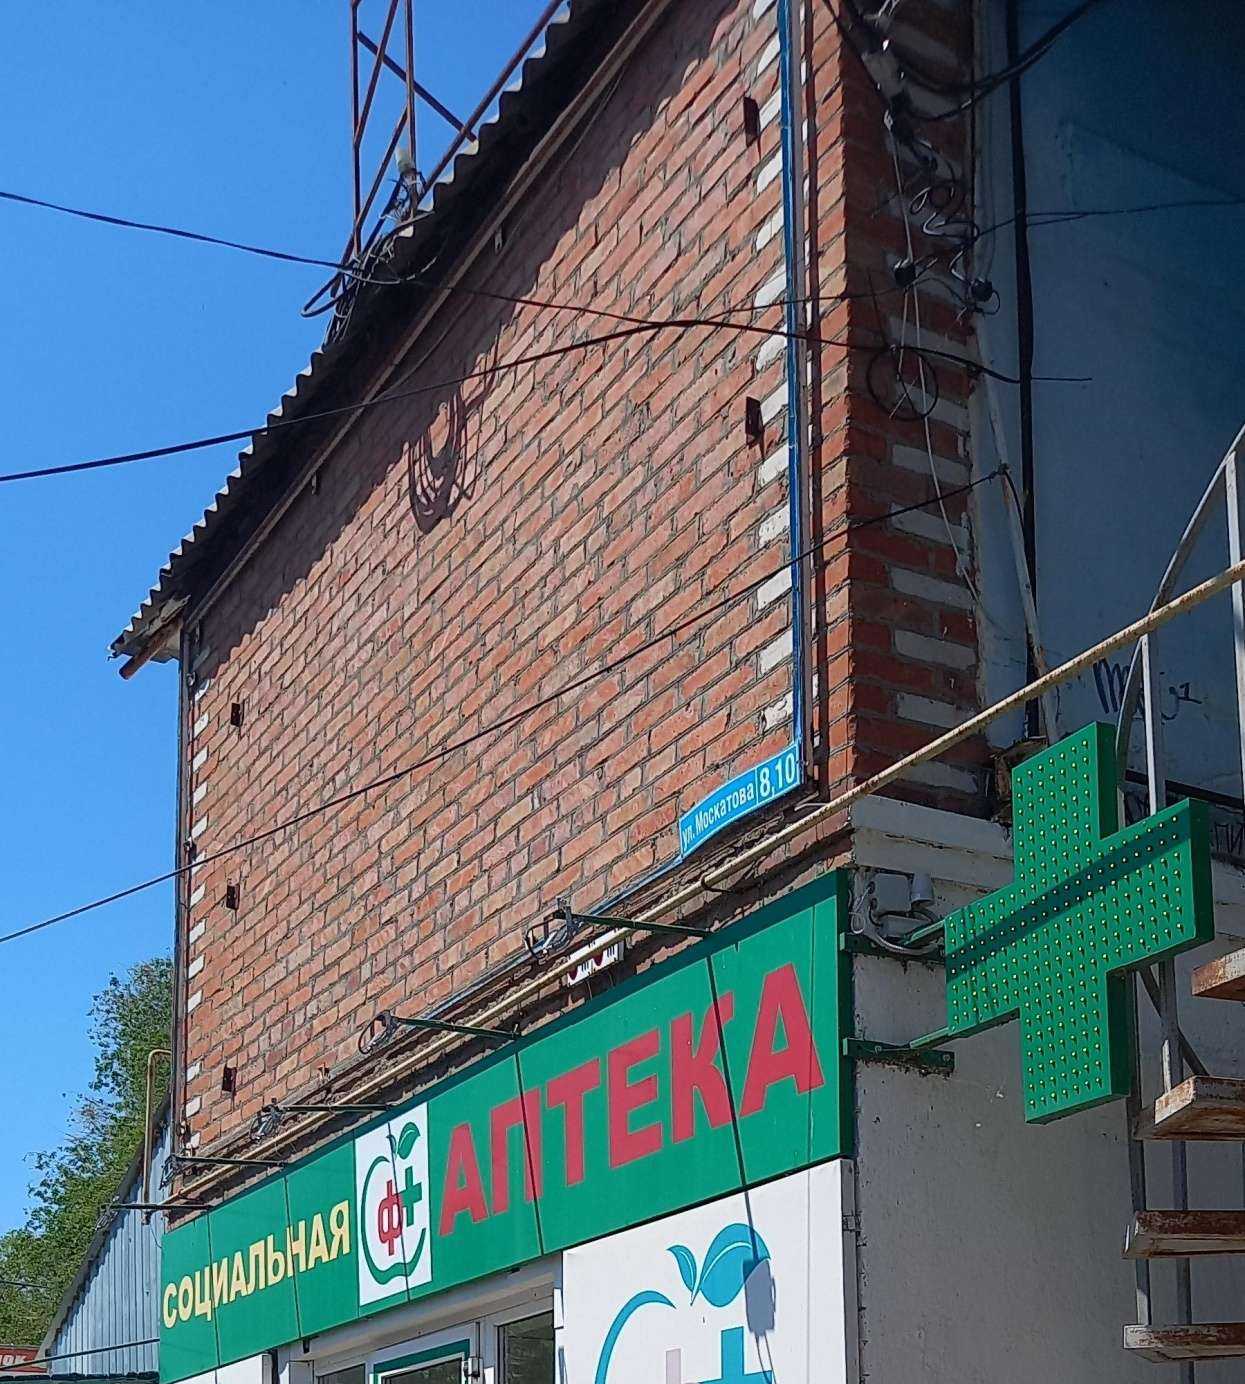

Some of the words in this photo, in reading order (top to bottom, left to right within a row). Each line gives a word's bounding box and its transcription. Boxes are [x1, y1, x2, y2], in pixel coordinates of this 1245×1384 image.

[682, 826, 695, 848] ул.
[695, 783, 755, 835] Москатова
[759, 752, 796, 799] 8,10
[438, 961, 826, 1237] АПТЕКА
[163, 1199, 351, 1329] СОЦИАЛЬНАЯ
[0, 1354, 27, 1368] ОК
